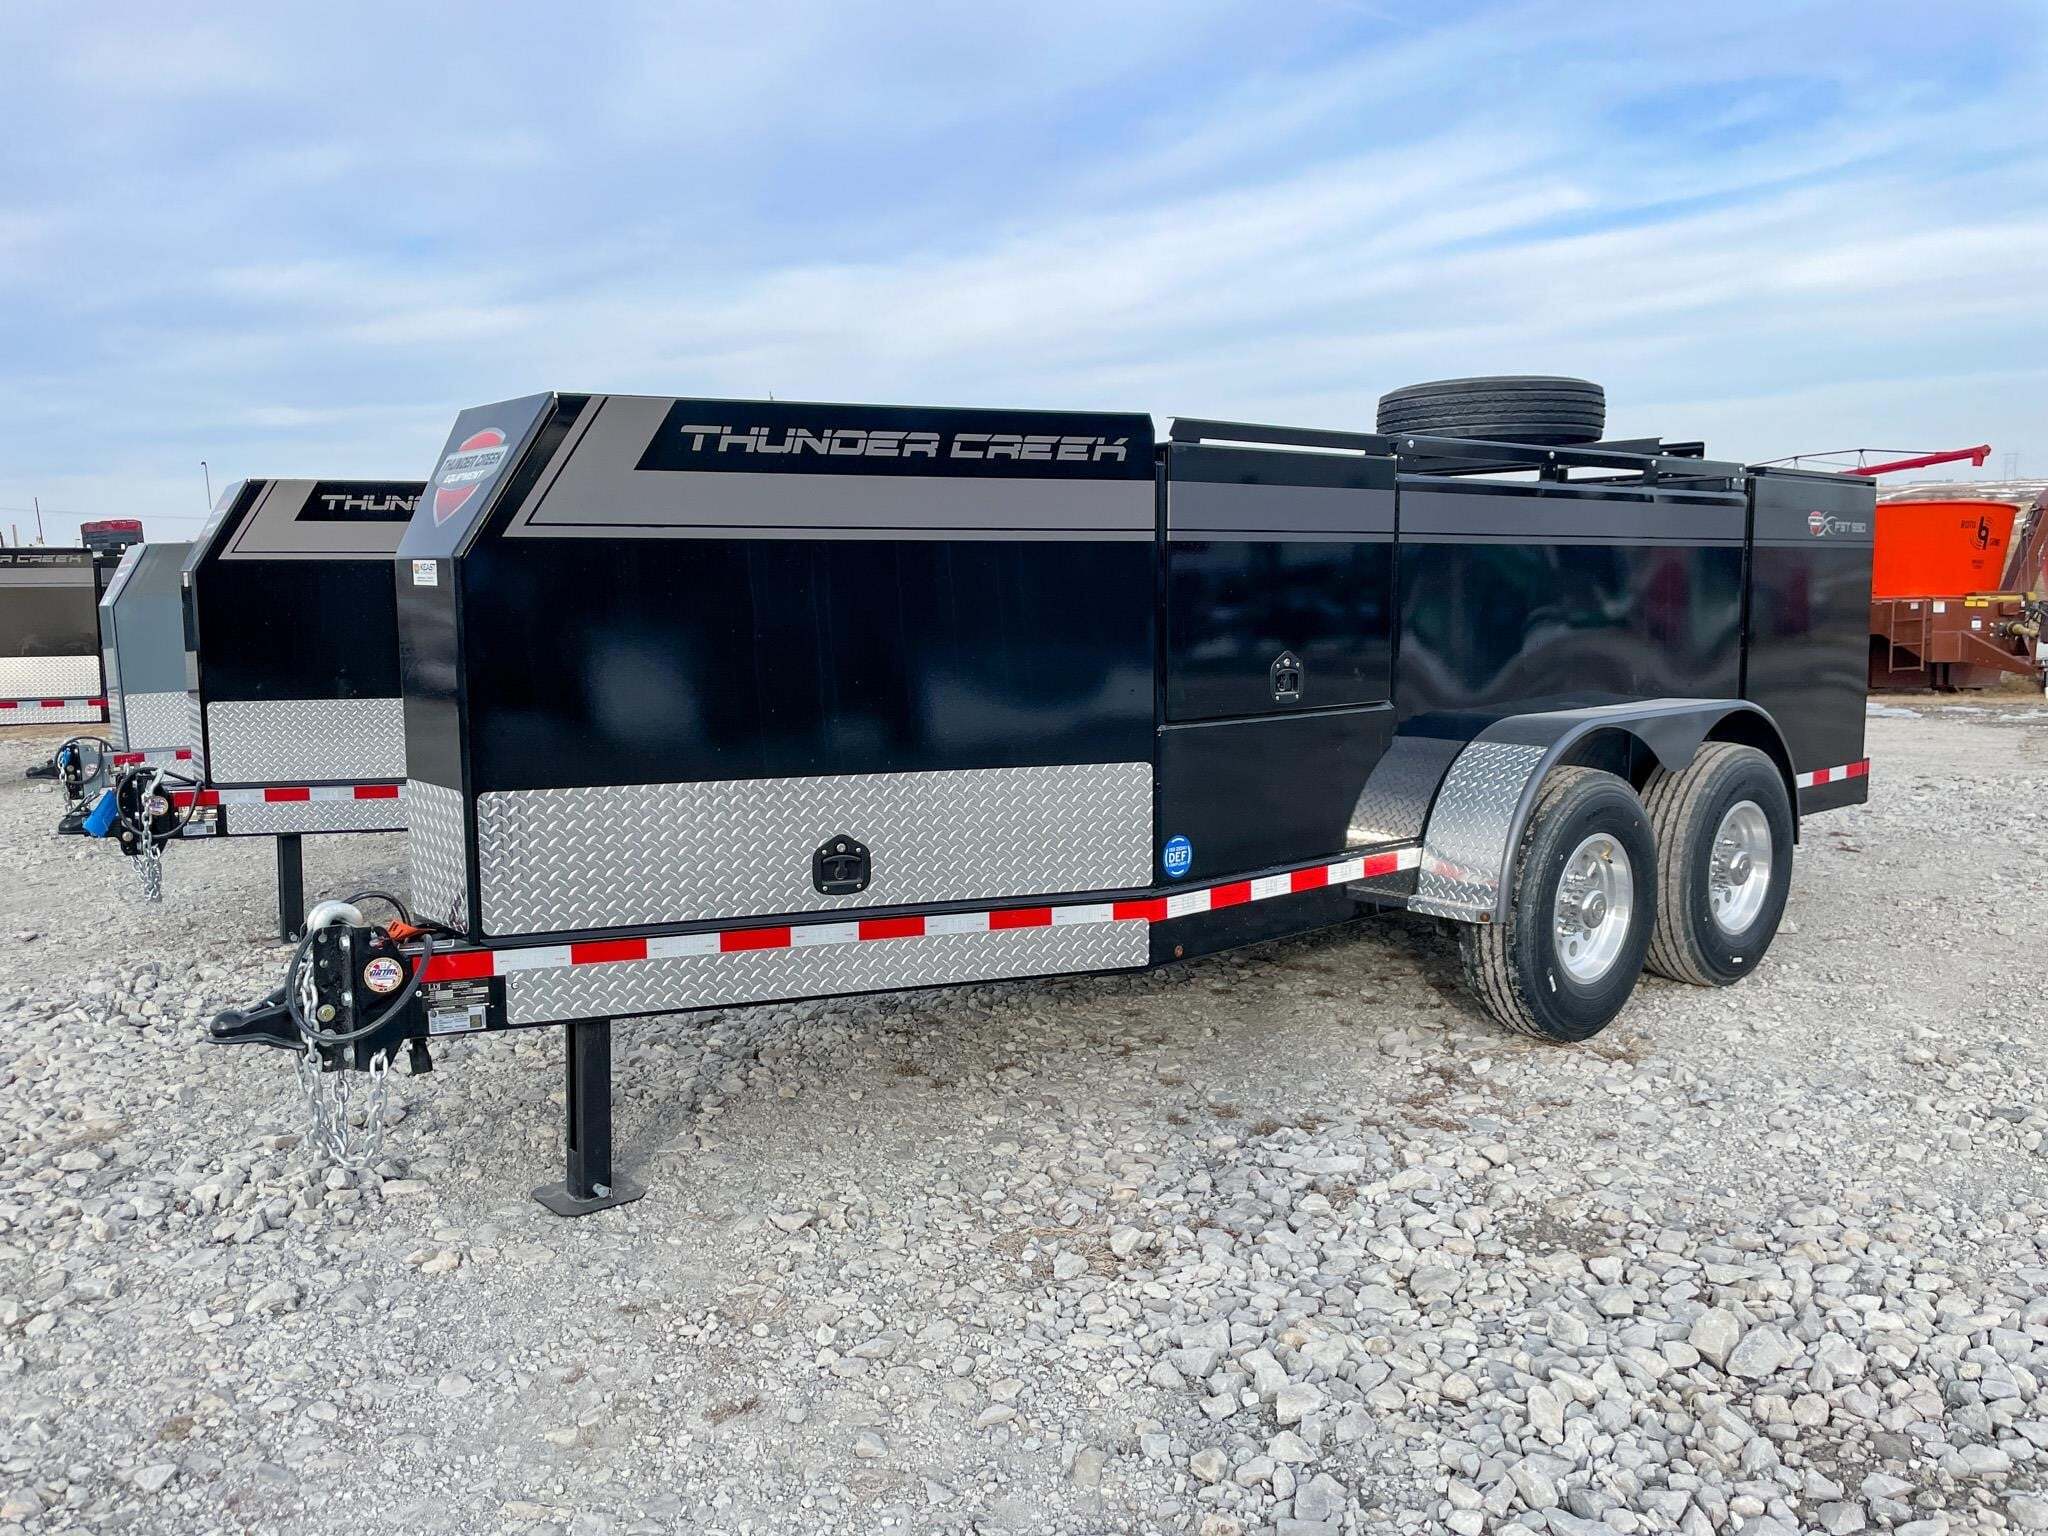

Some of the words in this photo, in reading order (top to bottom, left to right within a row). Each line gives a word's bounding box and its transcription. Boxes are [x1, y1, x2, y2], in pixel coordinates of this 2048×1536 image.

[681, 424, 940, 458] THUNDER
[950, 432, 1130, 462] CREEK
[442, 455, 477, 472] THUNDER
[474, 450, 504, 468] CREEK
[443, 470, 485, 484] EQUIPMENT
[17, 554, 82, 563] CREEK
[1169, 850, 1187, 864] DEF
